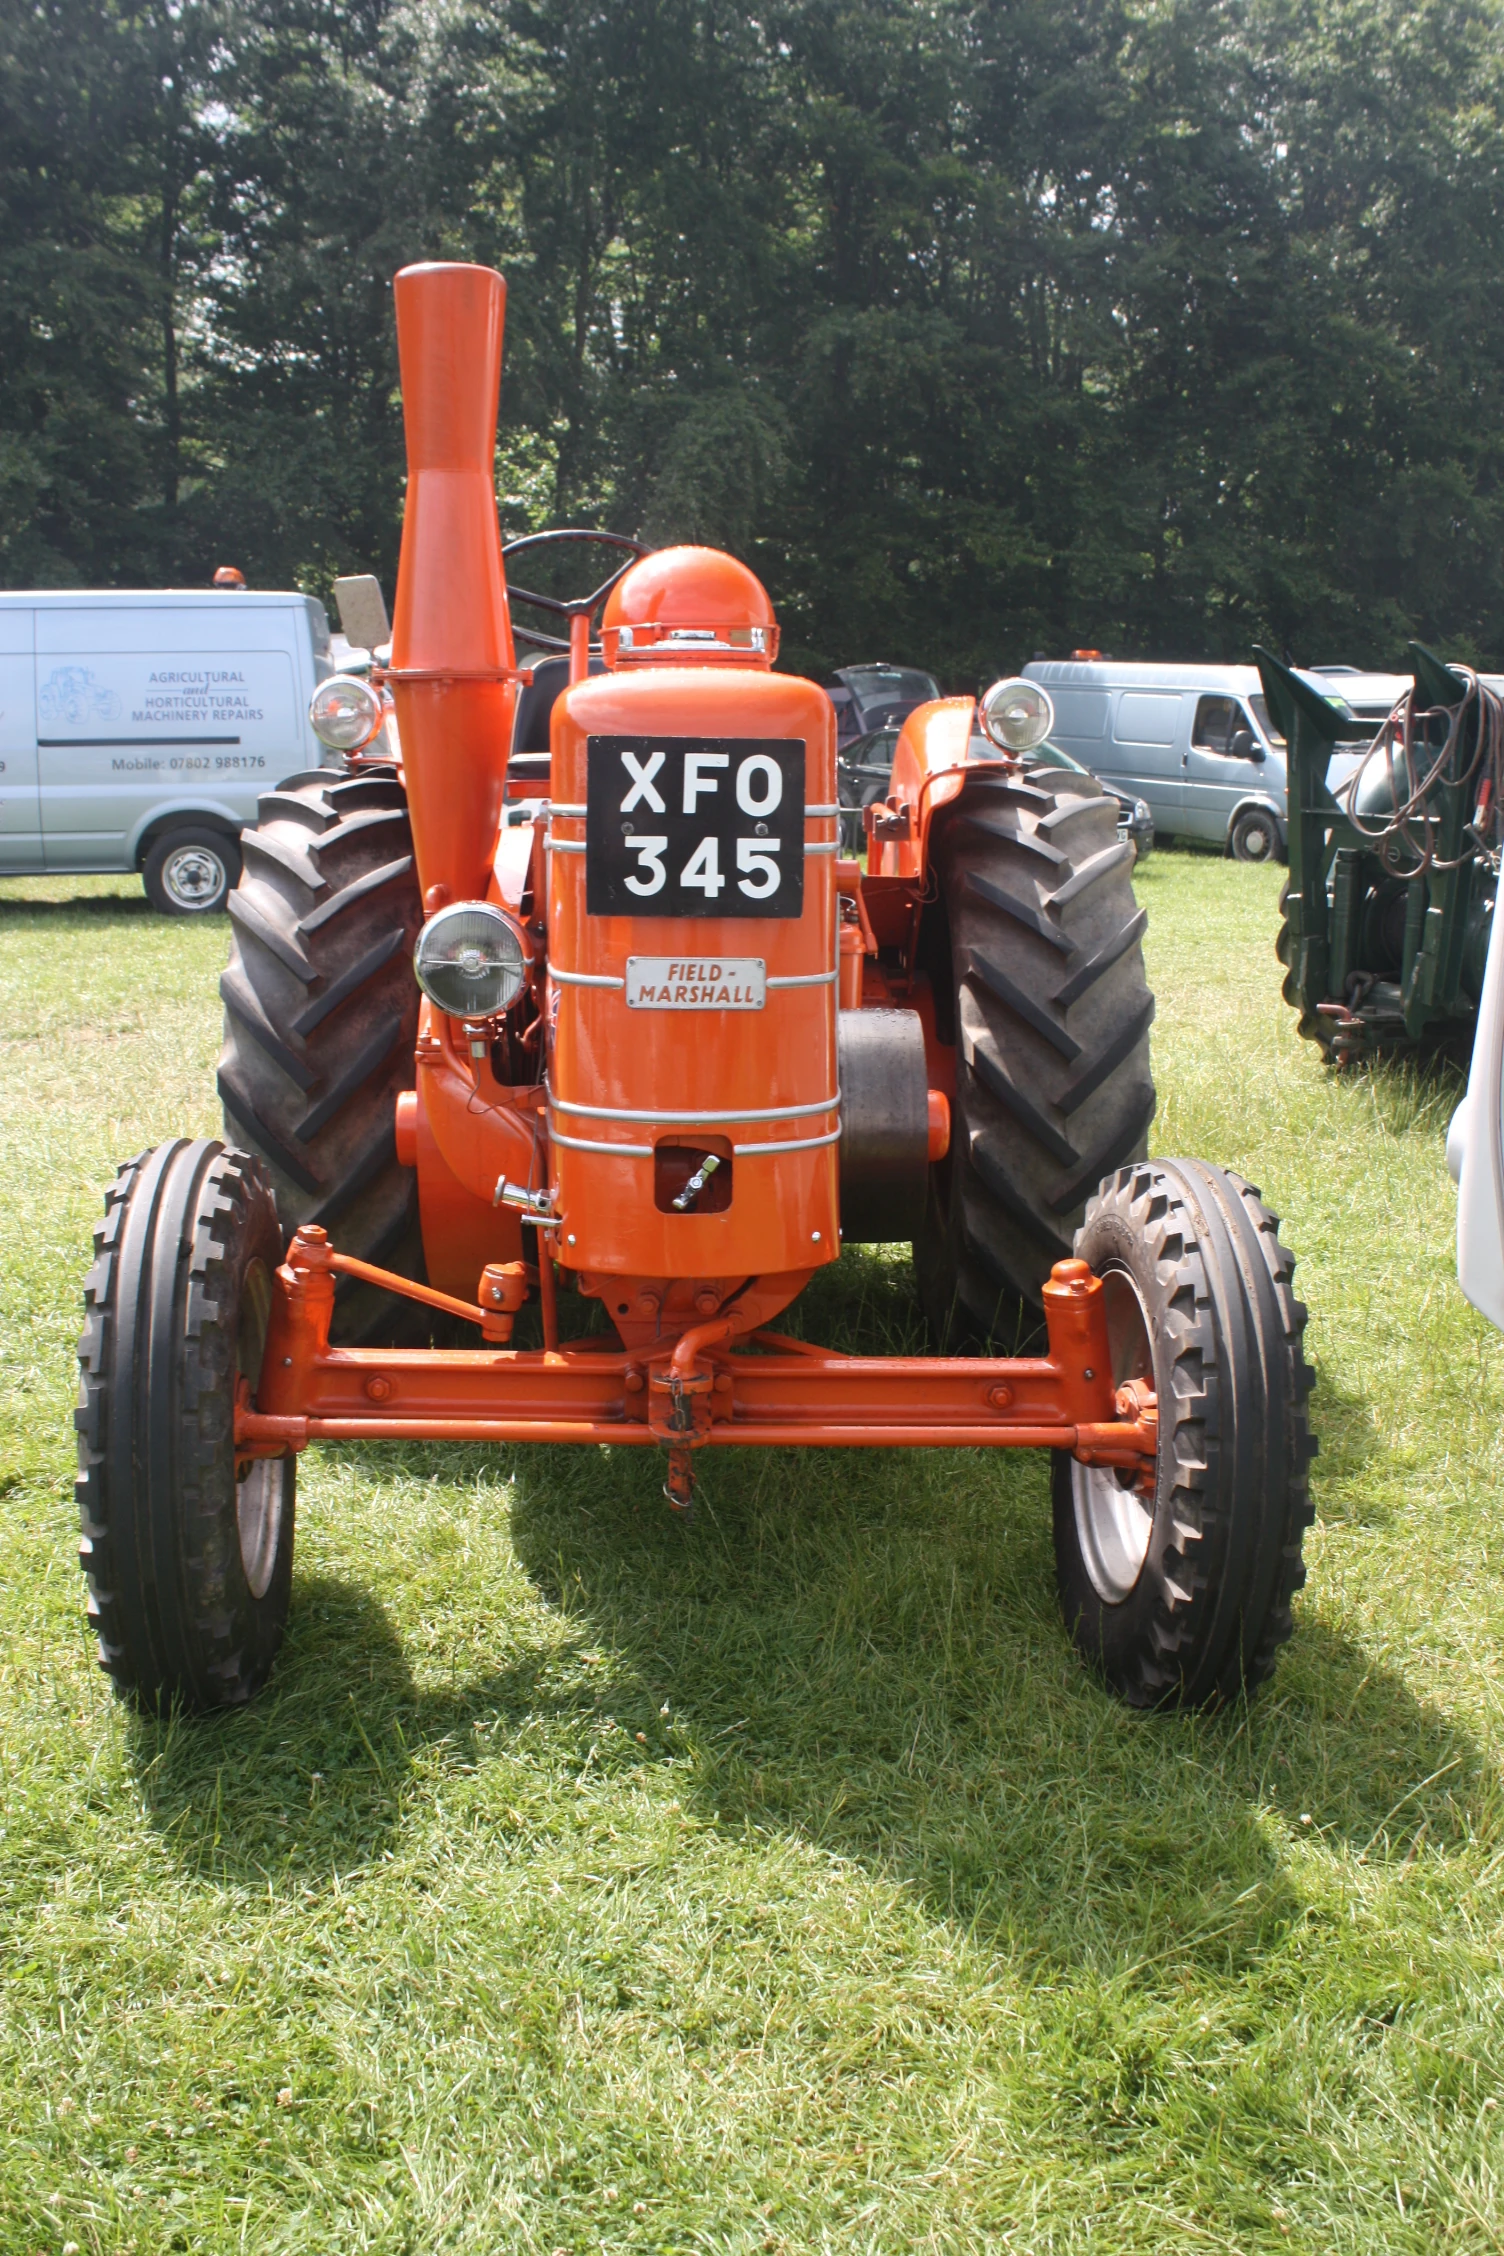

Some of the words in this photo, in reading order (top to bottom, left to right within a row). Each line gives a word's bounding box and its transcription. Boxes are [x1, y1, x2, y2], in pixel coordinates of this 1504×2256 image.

[149, 671, 245, 683] AGRICULTURAL
[182, 682, 210, 695] and
[145, 696, 249, 708] HORTICULTURAL
[131, 710, 208, 722] MACHINERY
[212, 709, 264, 721] REPAIRS
[111, 758, 165, 770] Mobile:
[169, 757, 211, 769] 07802
[215, 756, 265, 768] 988176
[620, 752, 783, 817] XFO
[623, 835, 781, 899] 345
[639, 985, 754, 1003] MARSHALL
